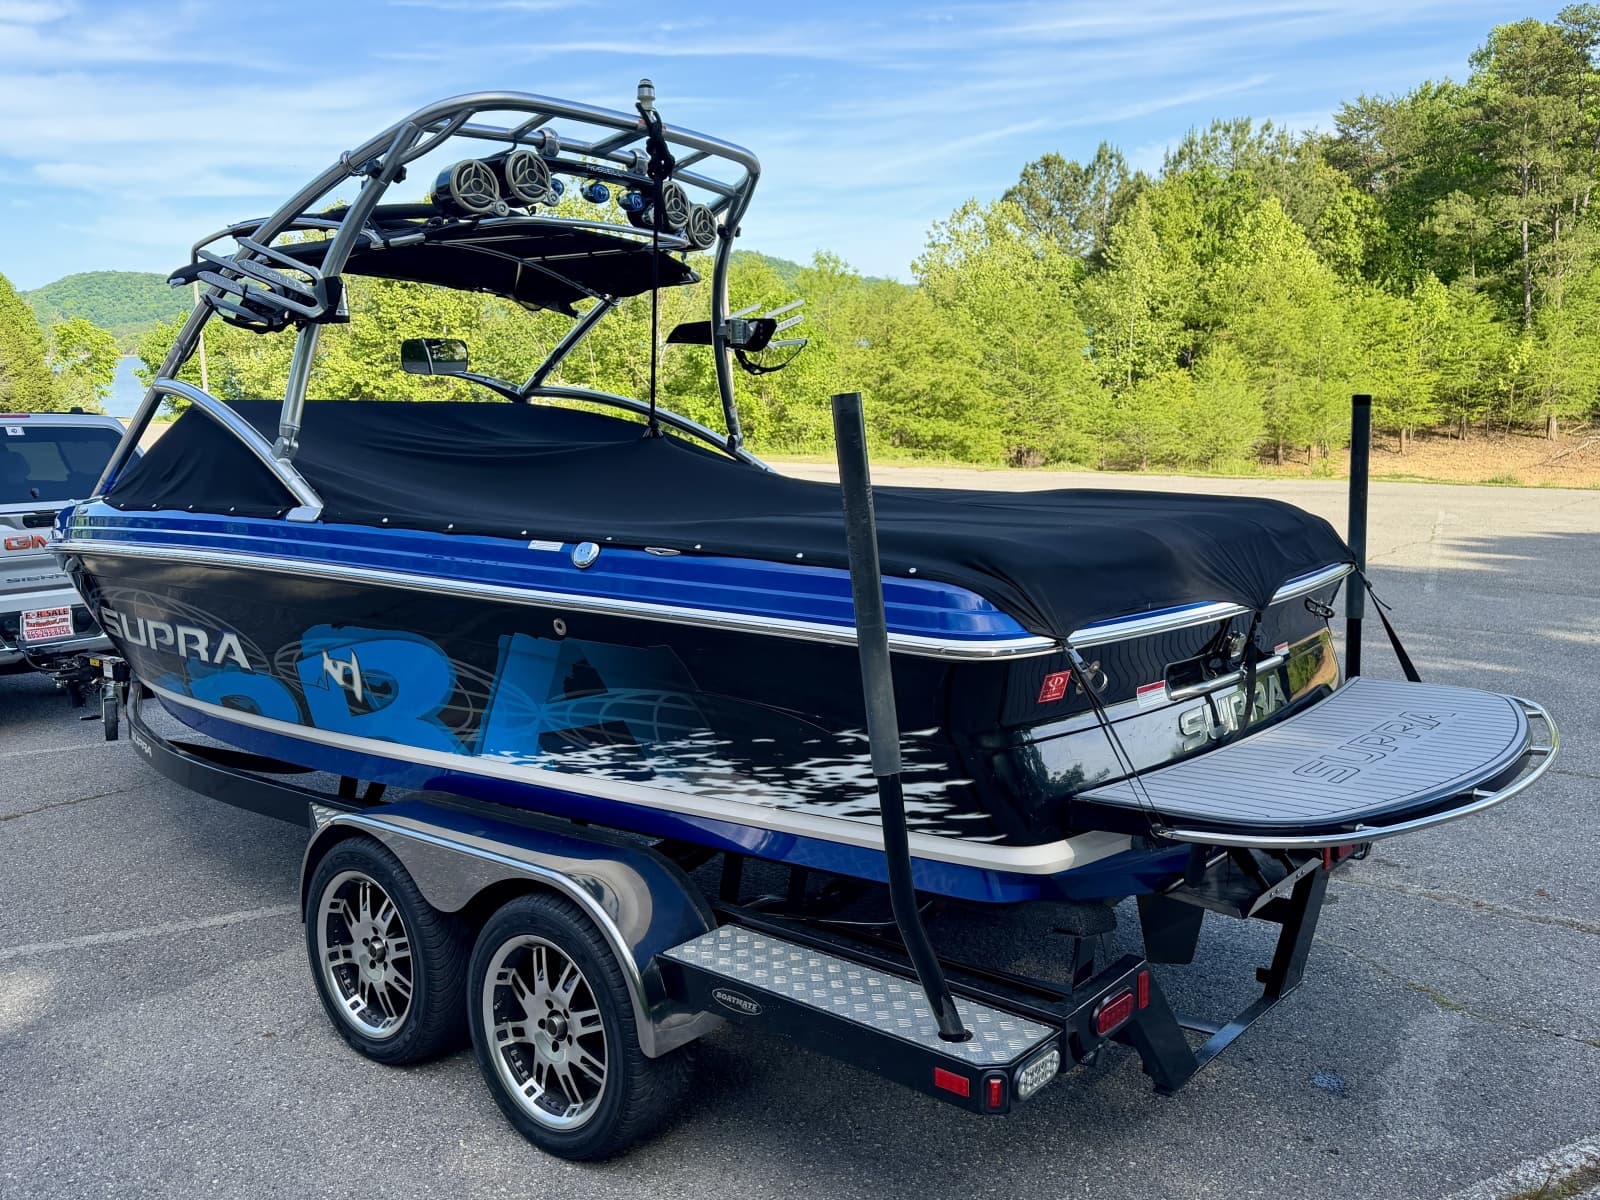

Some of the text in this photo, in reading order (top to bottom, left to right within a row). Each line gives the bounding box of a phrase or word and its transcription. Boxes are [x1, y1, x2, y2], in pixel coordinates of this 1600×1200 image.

[4, 534, 48, 551] GM
[101, 606, 252, 671] SUPRA
[1180, 674, 1289, 752] SUPRA
[716, 991, 758, 1011] BOATMATE
